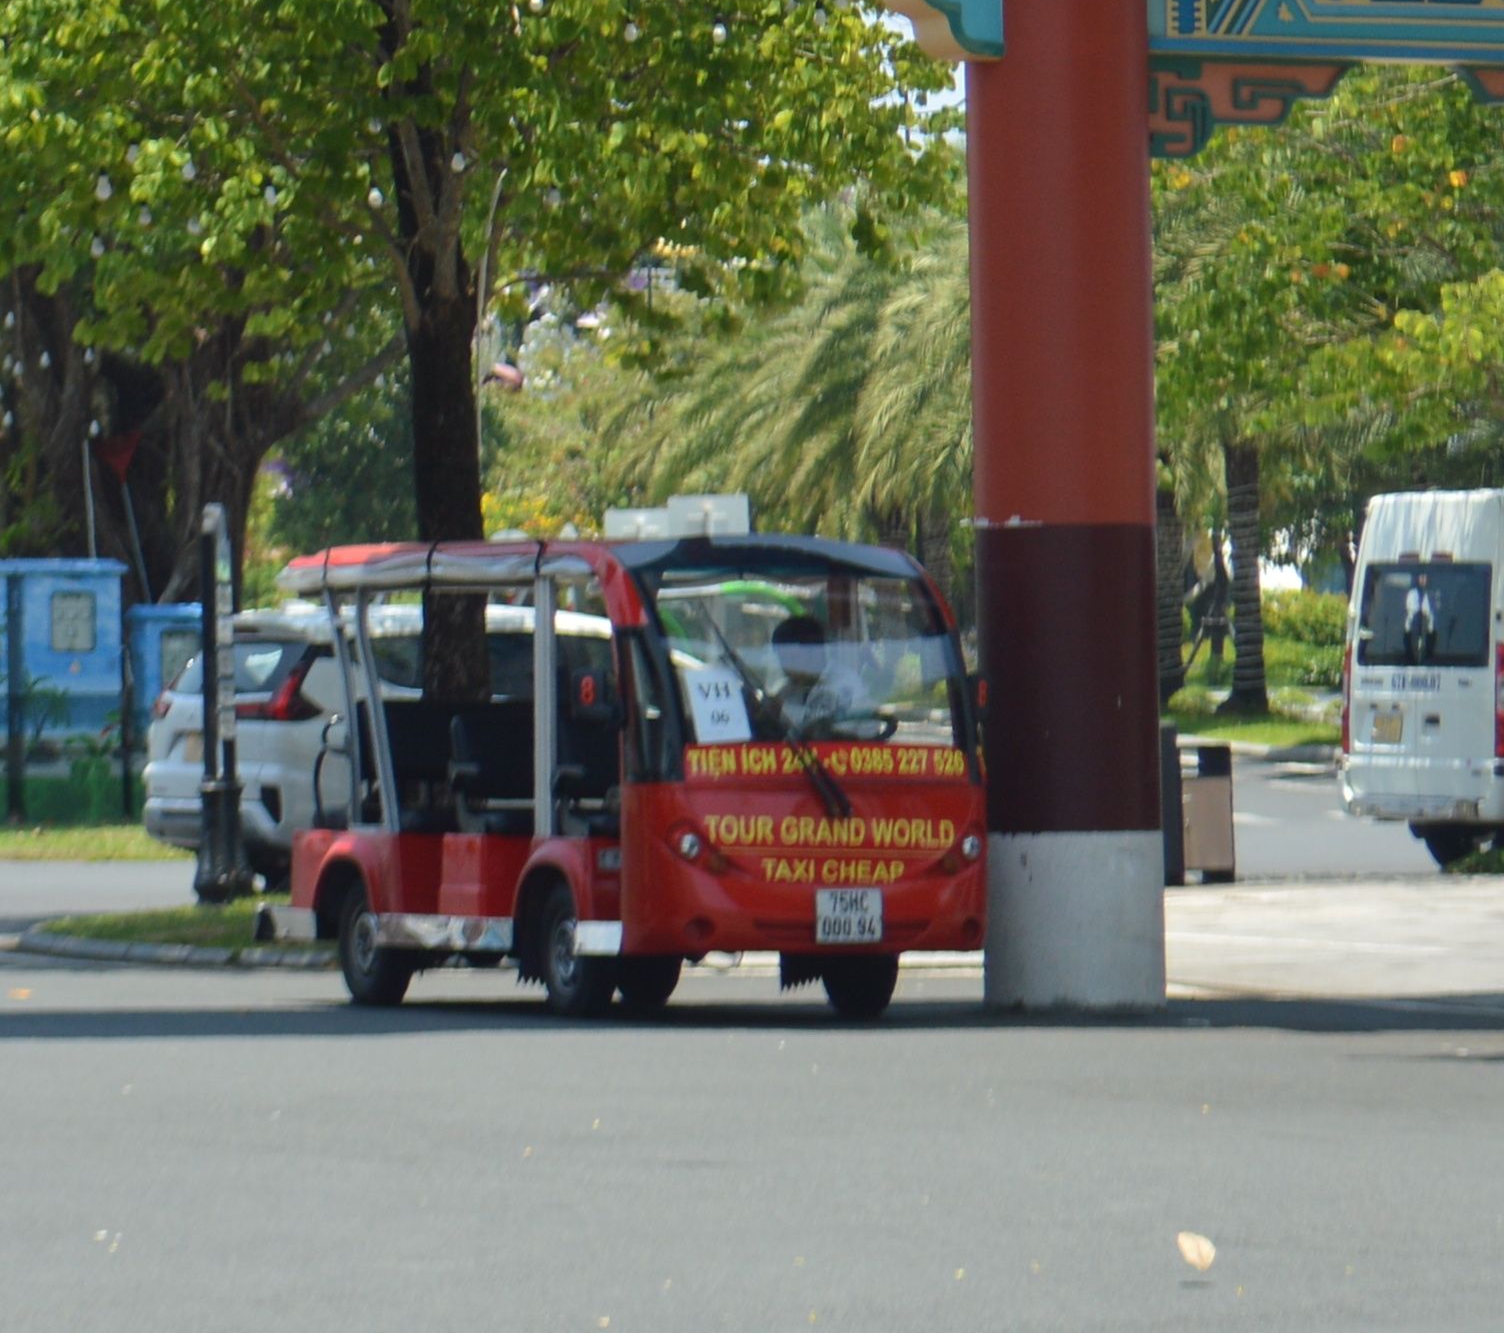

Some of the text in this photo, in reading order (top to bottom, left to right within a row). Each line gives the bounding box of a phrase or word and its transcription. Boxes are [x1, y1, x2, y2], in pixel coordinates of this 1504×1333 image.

[580, 675, 596, 706] 8
[688, 745, 736, 780] TIỆN
[742, 744, 777, 774] ÍCH
[897, 749, 928, 775] 227
[704, 815, 955, 848] TOUR GRAND WORLD
[761, 858, 905, 884] TAXI CHEAP
